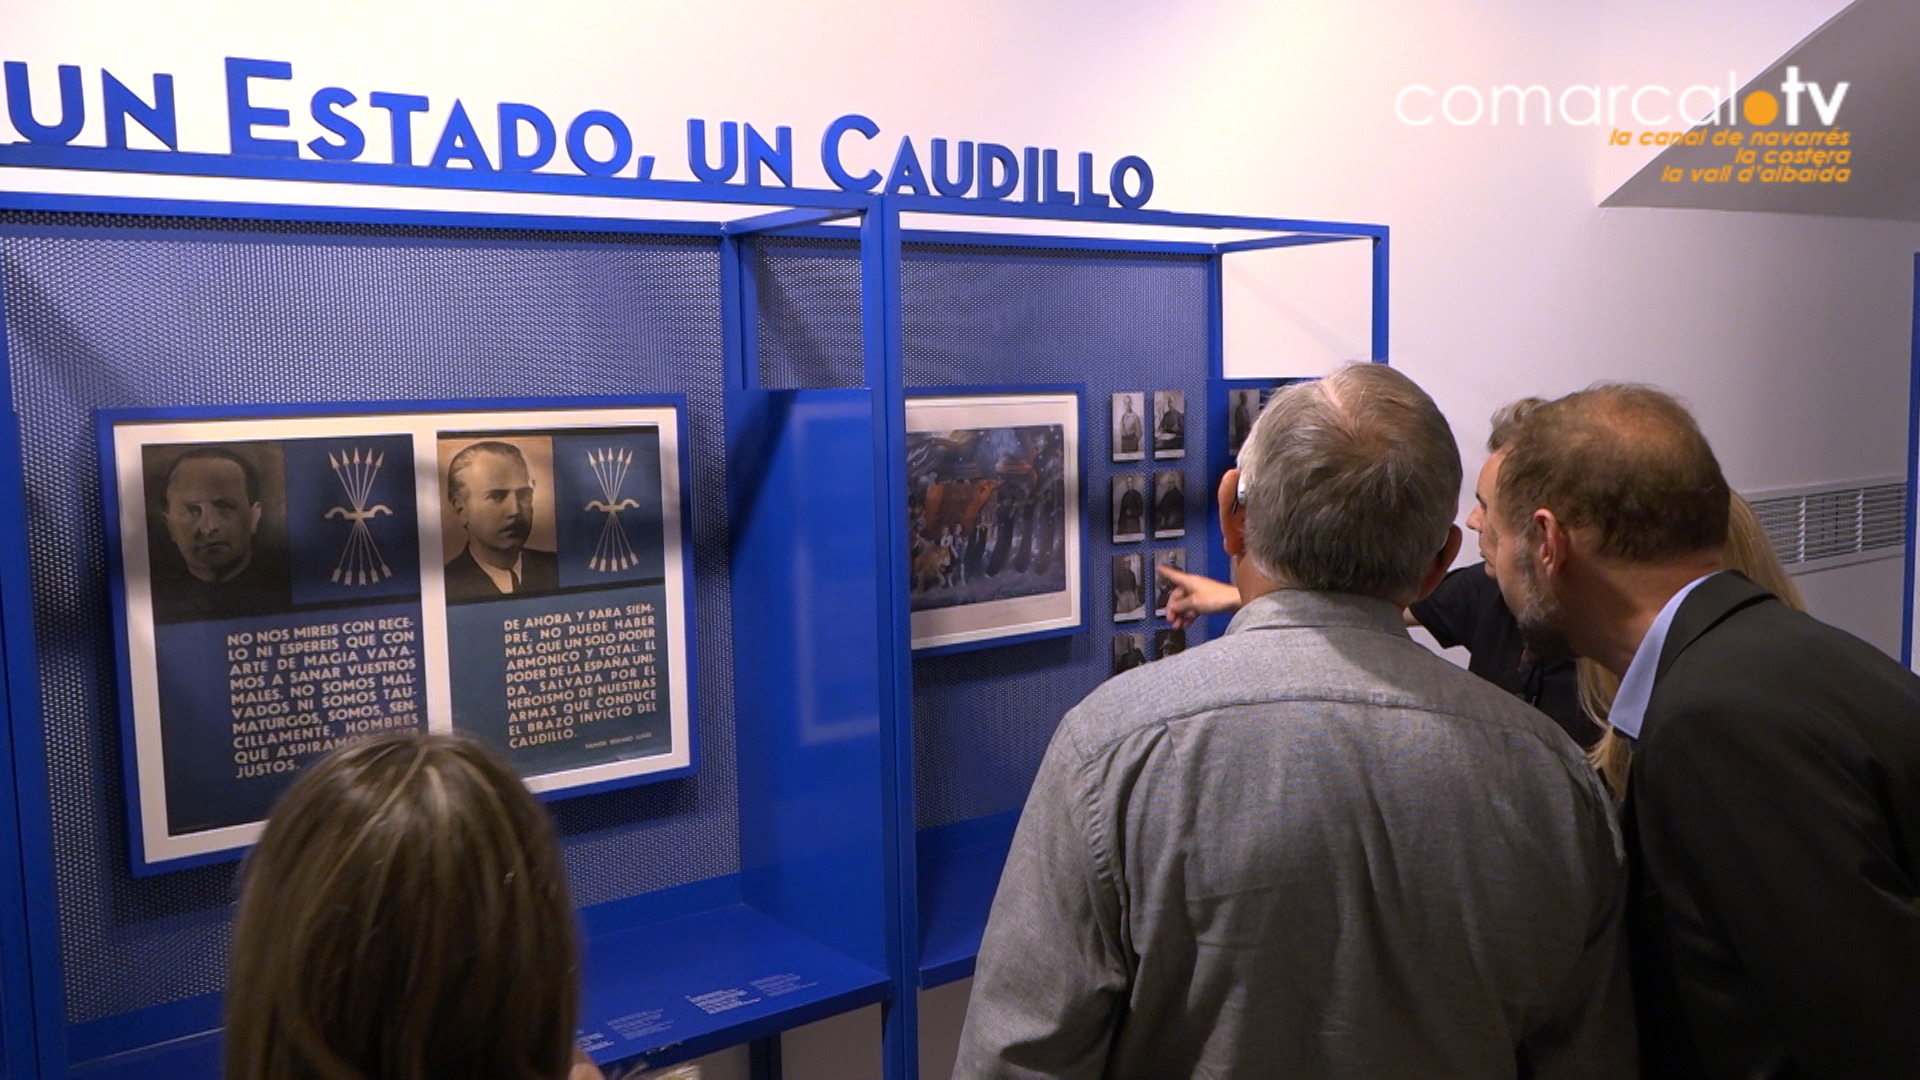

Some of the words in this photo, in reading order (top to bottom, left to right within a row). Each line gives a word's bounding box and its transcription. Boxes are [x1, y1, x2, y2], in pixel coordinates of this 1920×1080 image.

[4, 61, 178, 151] UN
[224, 56, 654, 180] ESTADO,
[687, 118, 792, 187] UN
[821, 114, 1154, 210] CAUDILLO
[227, 633, 253, 646] NO
[257, 629, 289, 643] NOS
[294, 624, 339, 639] MIREIS
[342, 621, 375, 634] CON
[379, 617, 414, 630] RECE-
[504, 620, 519, 631] DE
[525, 613, 571, 628] AHORA
[577, 611, 584, 621] Y
[589, 607, 621, 619] PARA
[540, 628, 561, 639] NO
[569, 622, 608, 635] PUEDE
[615, 616, 655, 629] HABER
[229, 648, 248, 661] LO
[256, 646, 272, 657] NI
[280, 639, 339, 655] ESPEREIS
[346, 634, 376, 649] QUE
[383, 632, 414, 644] CON
[506, 644, 533, 657] MAS
[536, 641, 561, 654] QUE
[565, 639, 581, 648] UN
[585, 633, 615, 645] SOLO
[506, 651, 579, 671] ARMONICO
[586, 649, 593, 657] Y
[646, 640, 656, 650] EL
[229, 660, 269, 675] ARTE
[278, 657, 296, 670] DE
[304, 649, 359, 667] MAGIA
[367, 646, 415, 659] VAYA-
[230, 676, 265, 690] MOS
[272, 674, 283, 685] A
[290, 667, 341, 683] SANAR
[348, 658, 416, 675] VUESTROS
[506, 669, 546, 683] PODER
[550, 665, 564, 674] DE
[568, 663, 581, 673] LA
[585, 656, 629, 672] ESPAÑA
[291, 684, 315, 697] NO
[322, 678, 375, 693] SOMOS
[383, 674, 416, 686] MAL-
[540, 674, 602, 691] SALVADA
[611, 668, 637, 680] POR
[645, 666, 656, 675] EL
[232, 702, 289, 719] VADOS
[298, 699, 313, 711] NI
[322, 691, 377, 708] SOMOS
[384, 687, 418, 699] TAU-
[390, 701, 418, 712] SEN-
[507, 690, 574, 709] HEROISMO
[579, 688, 593, 698] DE
[598, 678, 656, 694] NUESTRAS
[508, 706, 557, 723] ARMAS
[563, 700, 590, 714] QUE
[597, 690, 656, 708] CONDUCE
[346, 714, 418, 733] HOMBRES
[509, 725, 521, 736] EL
[528, 716, 573, 732] BRAZO
[580, 705, 632, 723] INVICTO
[638, 702, 657, 714] DEL
[234, 748, 269, 764] QUE
[277, 734, 369, 757] ASPIRAMO
